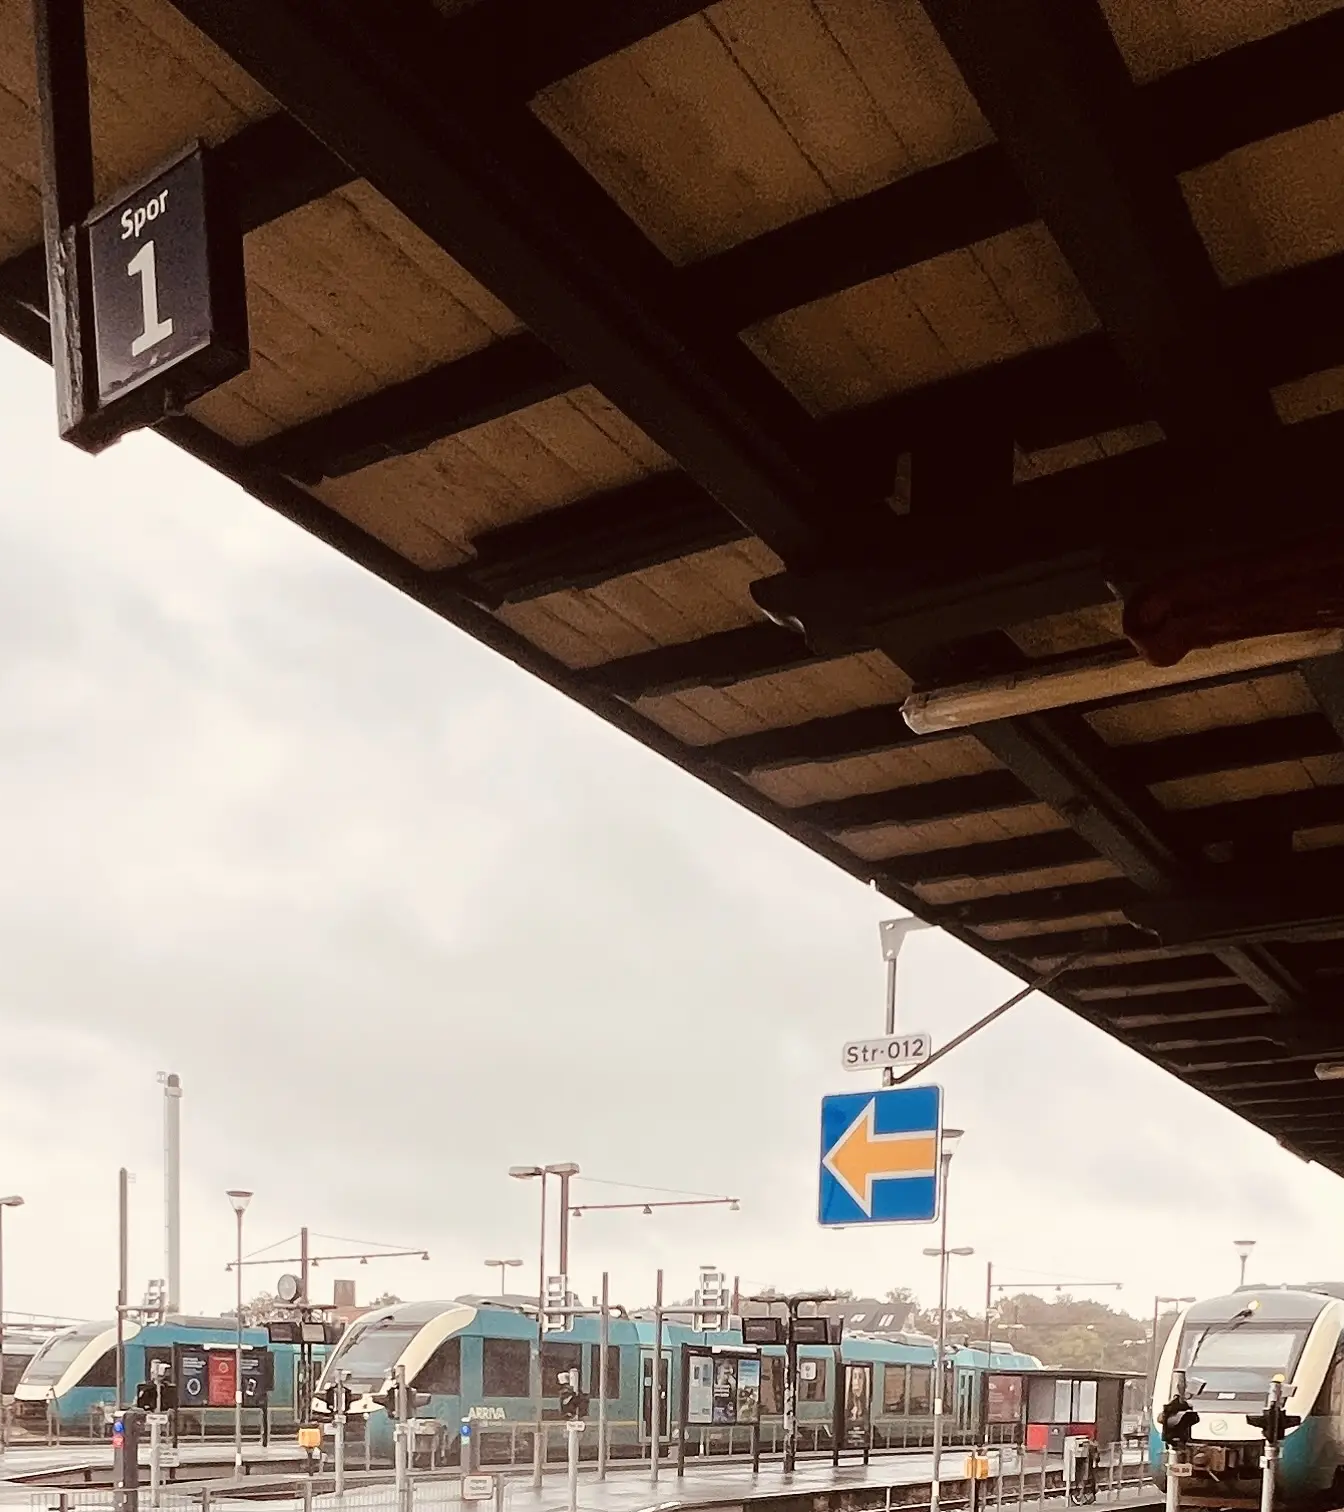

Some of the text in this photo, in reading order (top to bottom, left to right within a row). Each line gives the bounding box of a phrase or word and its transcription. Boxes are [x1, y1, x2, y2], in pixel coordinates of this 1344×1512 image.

[121, 189, 168, 240] Spor
[127, 240, 173, 357] 1
[468, 1406, 506, 1419] ARRIVA
